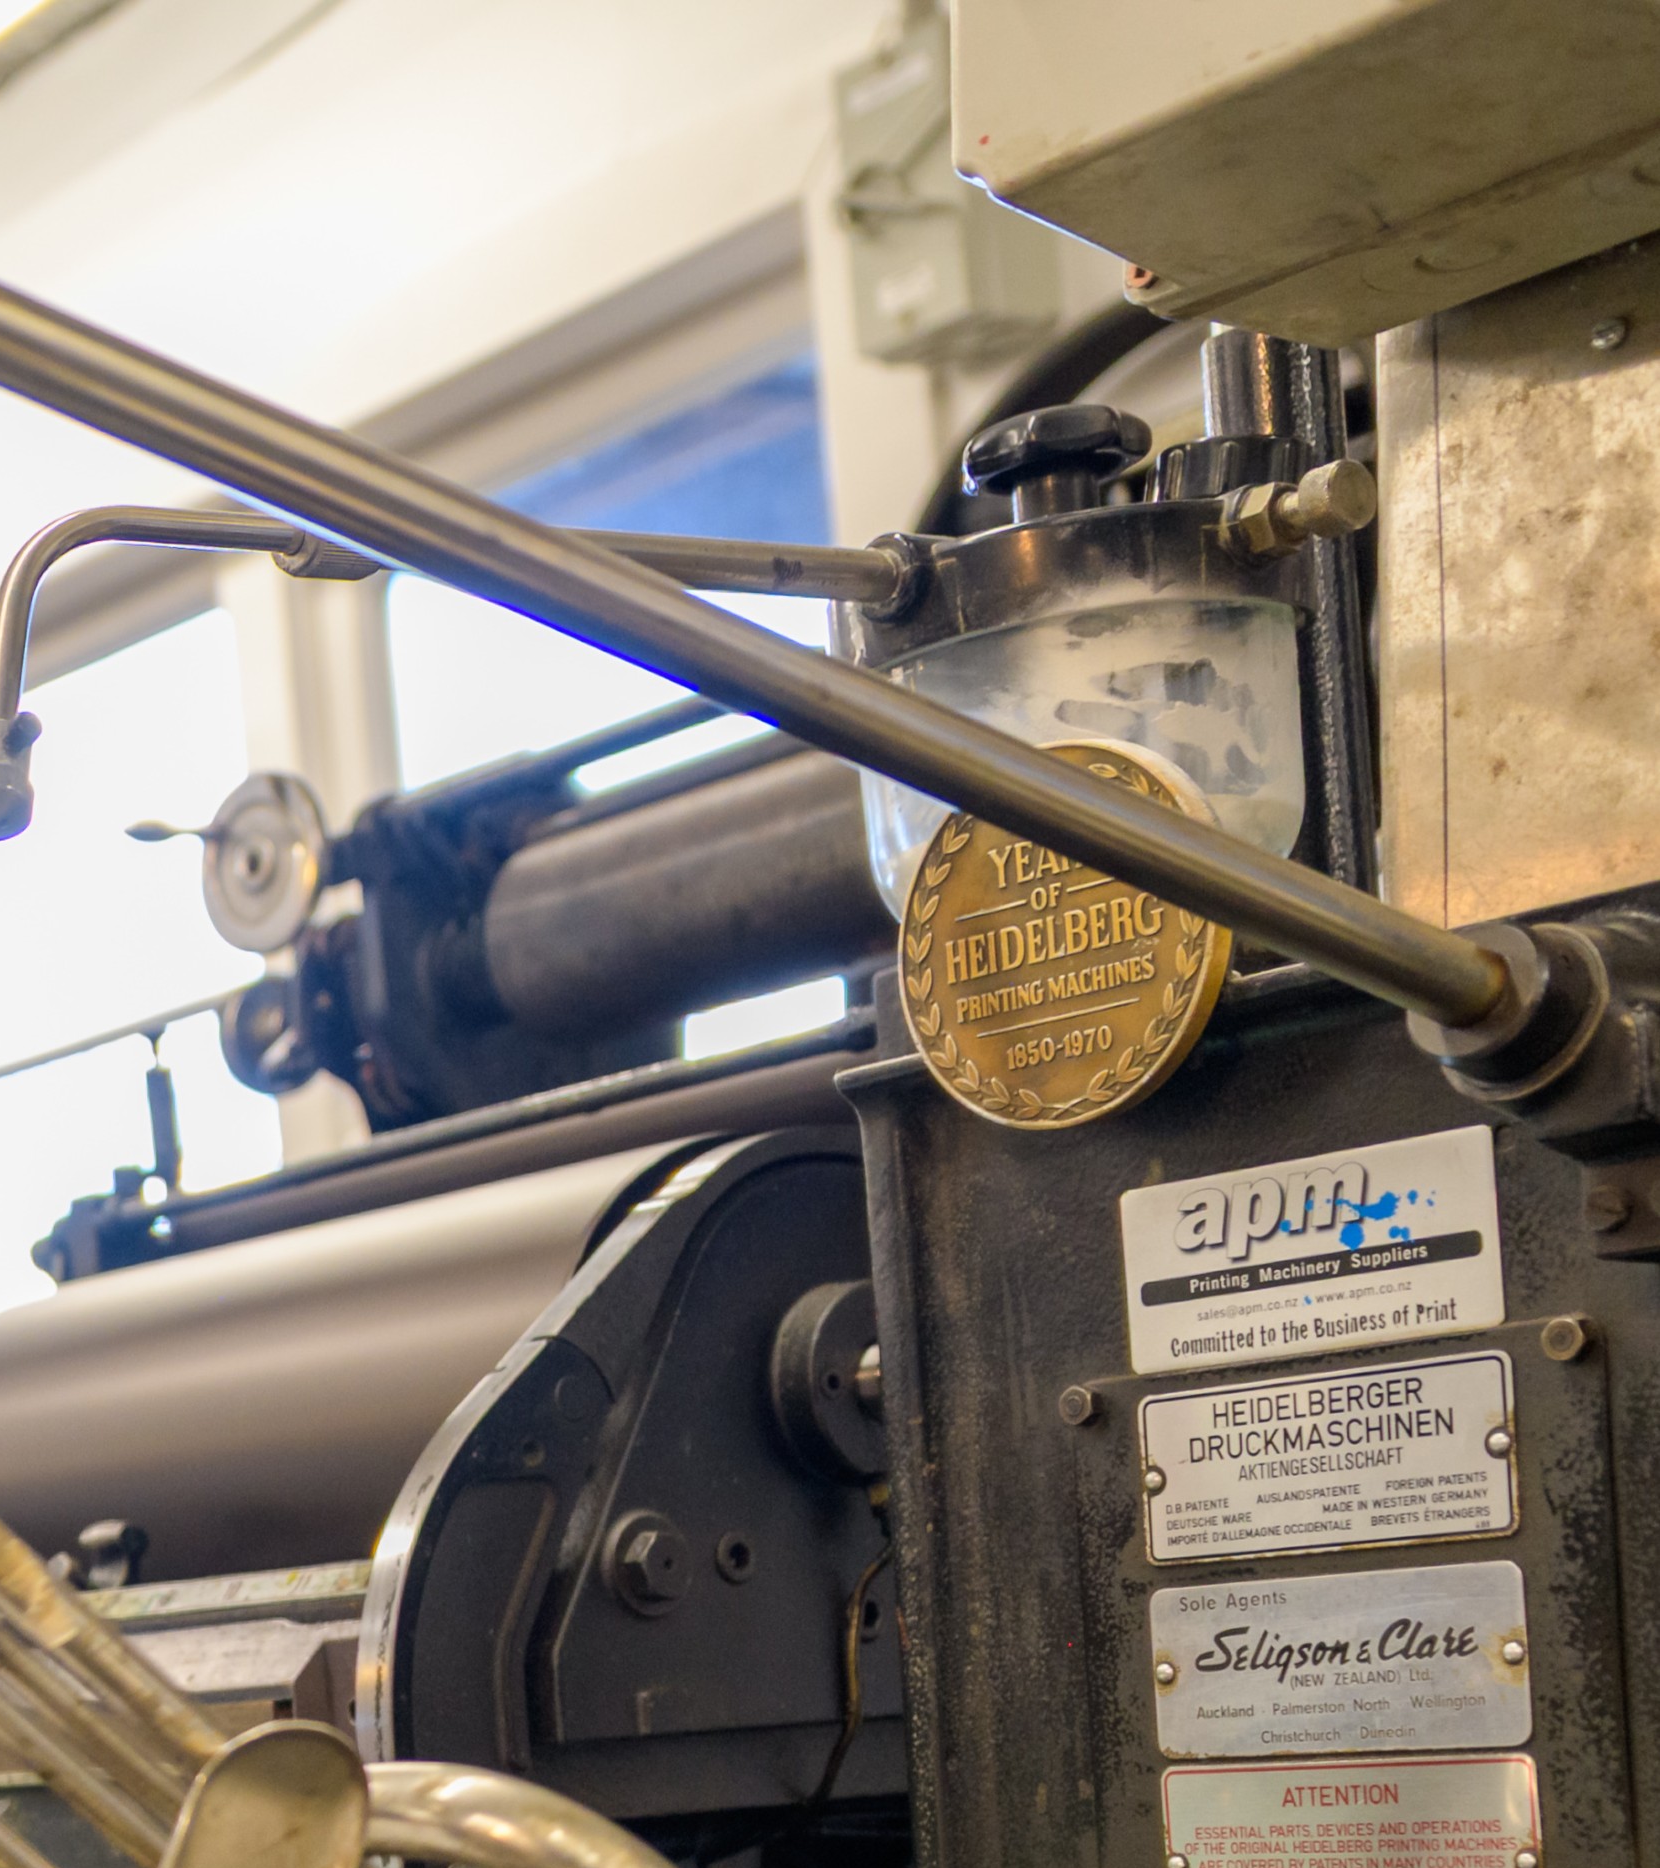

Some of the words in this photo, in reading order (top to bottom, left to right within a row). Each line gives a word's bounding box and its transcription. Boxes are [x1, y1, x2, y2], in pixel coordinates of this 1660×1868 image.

[988, 841, 1084, 889] YEA
[1030, 883, 1062, 911] OF
[945, 892, 1165, 985] HEIDELBERG
[956, 979, 1045, 1024] PRINTING
[1047, 952, 1155, 1001] MACHINES
[1007, 1025, 1113, 1071] 1850-1970
[1173, 1161, 1370, 1262] apm
[1190, 1270, 1249, 1295] Printing
[1259, 1258, 1341, 1285] Machinery
[1350, 1244, 1428, 1270] Suppliers
[1197, 1296, 1299, 1323] sales@apm.co.nz
[1315, 1280, 1412, 1305] www.apm.co.nz
[1170, 1322, 1256, 1359] Committed
[1260, 1325, 1276, 1347] to
[1282, 1320, 1309, 1343] the
[1315, 1309, 1388, 1341] Business
[1392, 1306, 1410, 1327] of
[1415, 1299, 1457, 1324] Print
[1211, 1378, 1424, 1428] HEIDELBERGER
[1189, 1407, 1455, 1464] DRUCKMASCHINEN
[1238, 1448, 1404, 1482] AKTIENGESELLSCHAFT
[1166, 1516, 1218, 1531] DEUTSCHE
[1222, 1512, 1252, 1524] WARE
[1322, 1502, 1354, 1514] MADE
[1357, 1500, 1368, 1510] IN
[1372, 1495, 1427, 1509] WESTERN
[1431, 1488, 1489, 1503] GERMANY
[1256, 1484, 1361, 1505] AUSLANDSPATENTE
[1386, 1477, 1434, 1491] FOREIGN
[1438, 1472, 1487, 1487] PATENTS
[1168, 1531, 1209, 1547] IMPORTÉ
[1212, 1525, 1282, 1542] D'ALLEMAGNE
[1284, 1519, 1352, 1535] OCCIDENTALE
[1371, 1512, 1420, 1527] BREVETS
[1424, 1506, 1490, 1522] ÉTRANGERS
[1178, 1593, 1217, 1613] Sole
[1225, 1590, 1287, 1611] Agents
[1377, 1618, 1479, 1661] Clare
[1290, 1673, 1326, 1690] (NEW
[1334, 1670, 1402, 1687] ZEALAND)
[1196, 1703, 1255, 1720] Auckland
[1272, 1699, 1346, 1717] Palmerston
[1353, 1696, 1390, 1713] North
[1409, 1693, 1486, 1713] Wellington
[1261, 1726, 1341, 1745] Christchurch
[1359, 1724, 1416, 1741] Dunedin
[1281, 1783, 1399, 1809] ATTENTION
[1185, 1843, 1201, 1855] OF
[1203, 1843, 1226, 1855] THE
[1231, 1841, 1288, 1854] ORIGINAL
[1293, 1840, 1373, 1853] HEIDELBERG
[1378, 1839, 1440, 1852] PRINTING
[1444, 1837, 1517, 1851] MACHINES
[1195, 1827, 1263, 1840] ESSENTIAL
[1317, 1823, 1374, 1837] DEVICES
[1379, 1822, 1406, 1835] AND
[1413, 1819, 1501, 1834] OPERATIONS
[1427, 1856, 1506, 1868] COUNTRIES
